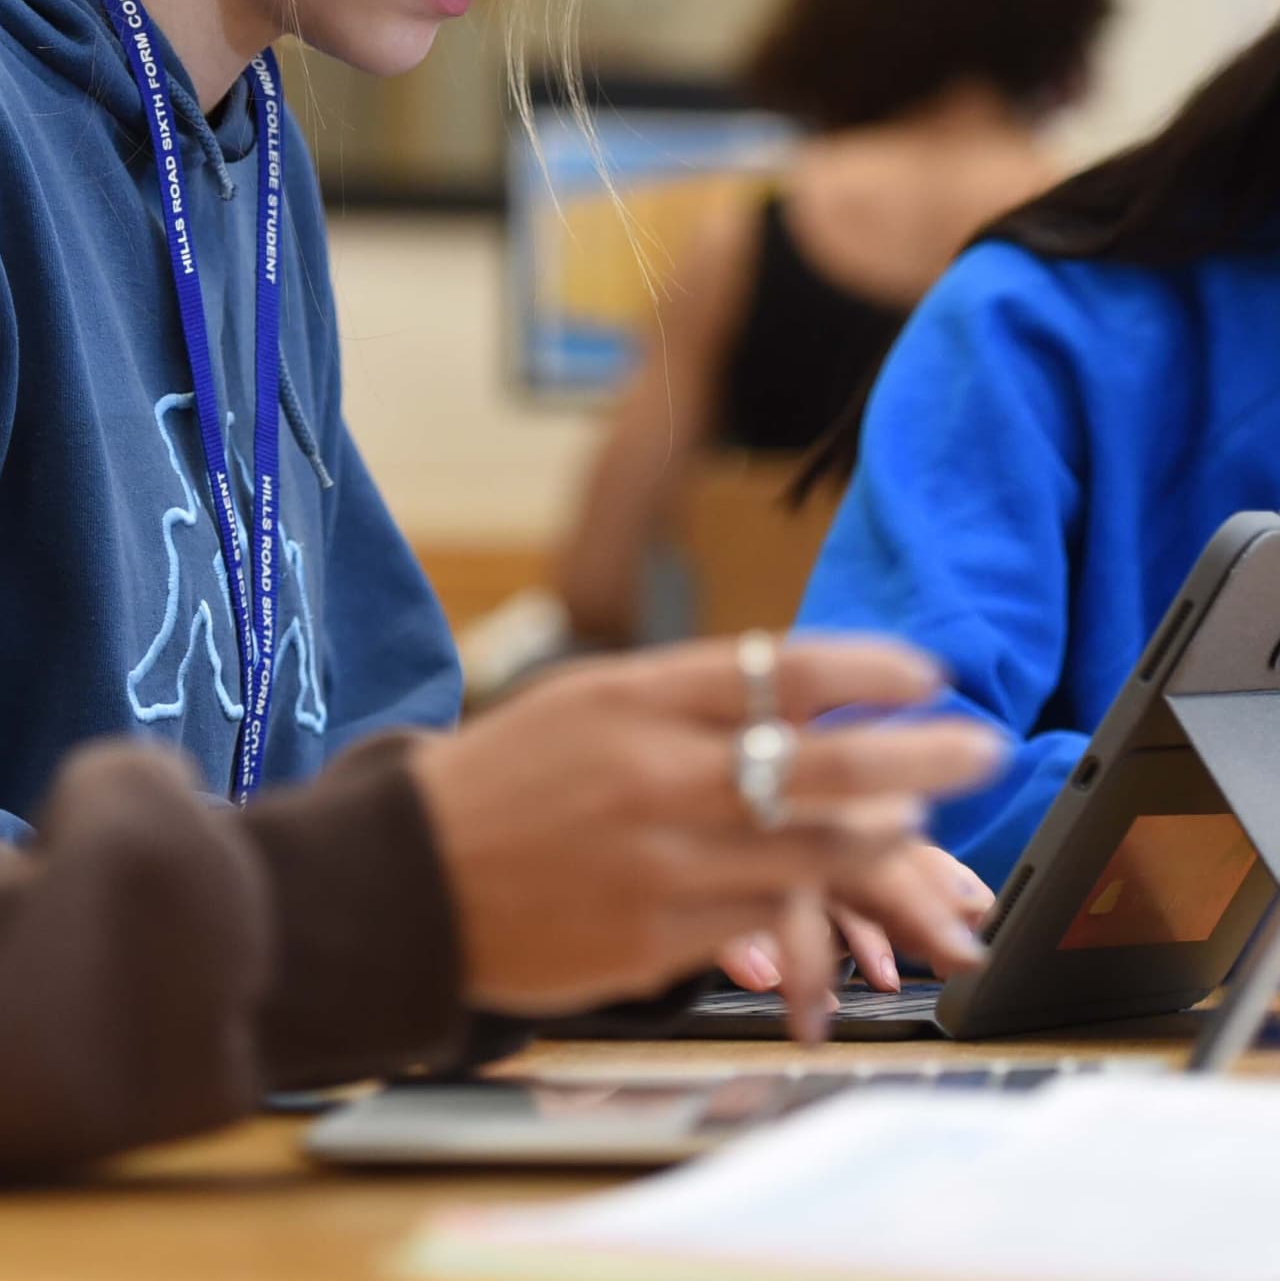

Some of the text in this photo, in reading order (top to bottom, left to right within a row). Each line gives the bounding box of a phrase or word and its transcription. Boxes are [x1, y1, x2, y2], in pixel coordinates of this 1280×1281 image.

[134, 33, 161, 89] FORM
[153, 94, 173, 152] SIXTH
[265, 99, 280, 191] COLLEGE
[165, 155, 183, 214] ROAD
[175, 218, 194, 275] HILLS
[265, 194, 279, 284] STUDENT
[216, 470, 241, 562] STUDENT
[261, 475, 272, 531] HILLS
[261, 535, 272, 592] ROAD
[235, 567, 252, 659] COLLEGE
[261, 596, 272, 653] SIXTH
[255, 657, 272, 716] FORM
